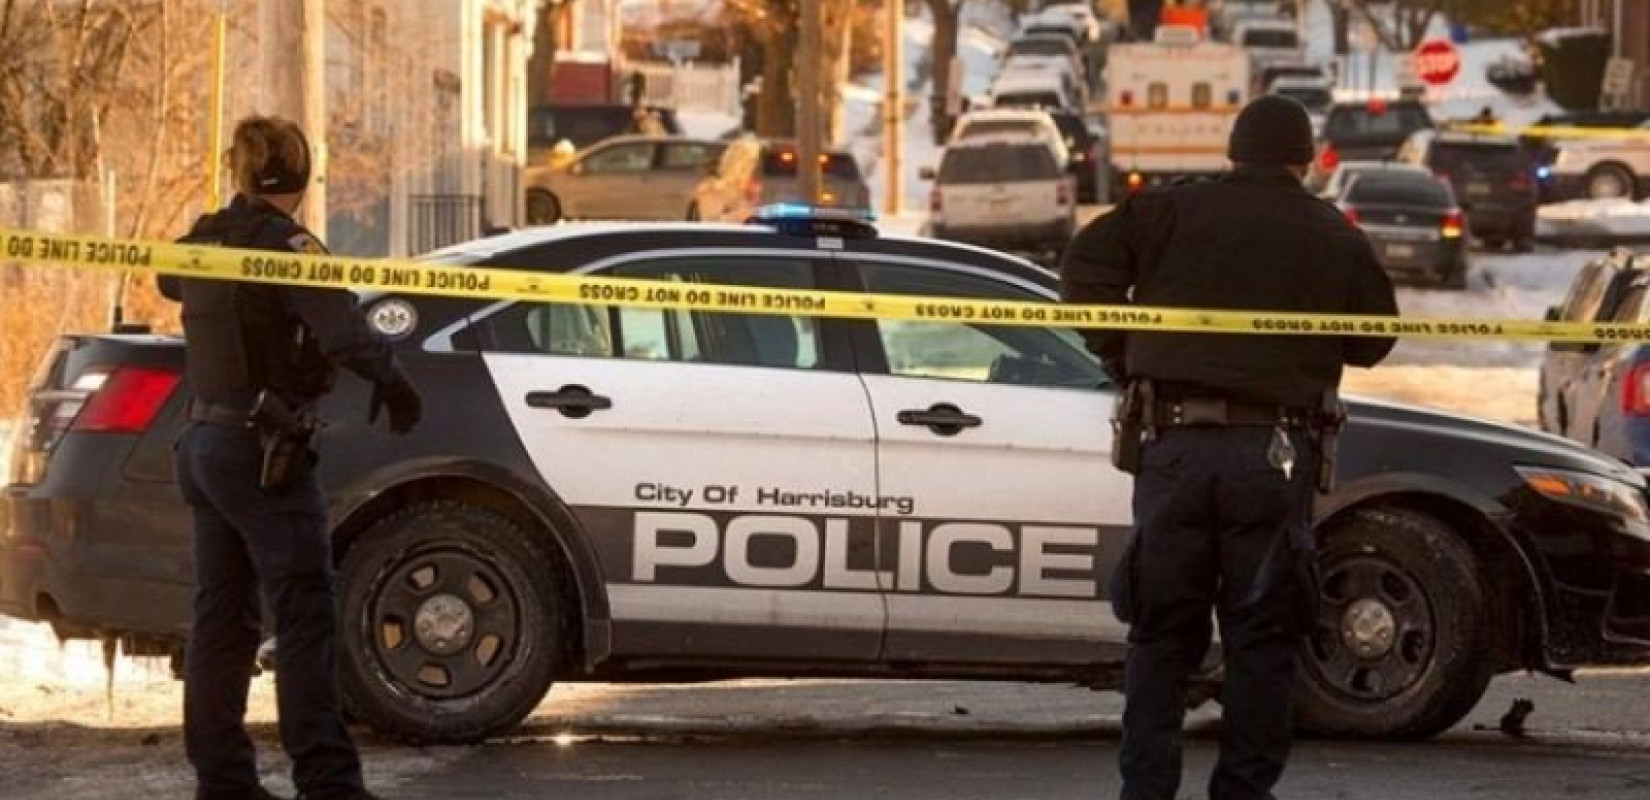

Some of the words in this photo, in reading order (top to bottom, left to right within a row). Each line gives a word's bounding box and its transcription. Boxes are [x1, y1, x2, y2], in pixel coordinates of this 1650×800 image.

[1416, 52, 1457, 73] STOP
[8, 235, 34, 258] DO
[40, 237, 79, 260] LINE
[86, 241, 152, 266] POLICE
[241, 256, 302, 280] CROSS
[309, 261, 344, 282] NOT
[349, 264, 376, 284] DO
[380, 267, 420, 286] LINE
[426, 269, 490, 291] POLICE
[579, 283, 639, 301] CROSS
[644, 286, 681, 302] NOT
[685, 288, 711, 304] DO
[716, 290, 756, 307] LINE
[762, 294, 826, 310] POLICE
[915, 304, 975, 319] CROSS
[980, 305, 1016, 319] NOT
[1022, 307, 1047, 320] DO
[1052, 308, 1092, 322] LINE
[1097, 311, 1162, 324] POLICE
[634, 482, 694, 506] City
[703, 485, 739, 505] Of
[755, 487, 915, 514] Harrisburg
[632, 511, 1098, 598] POLICE
